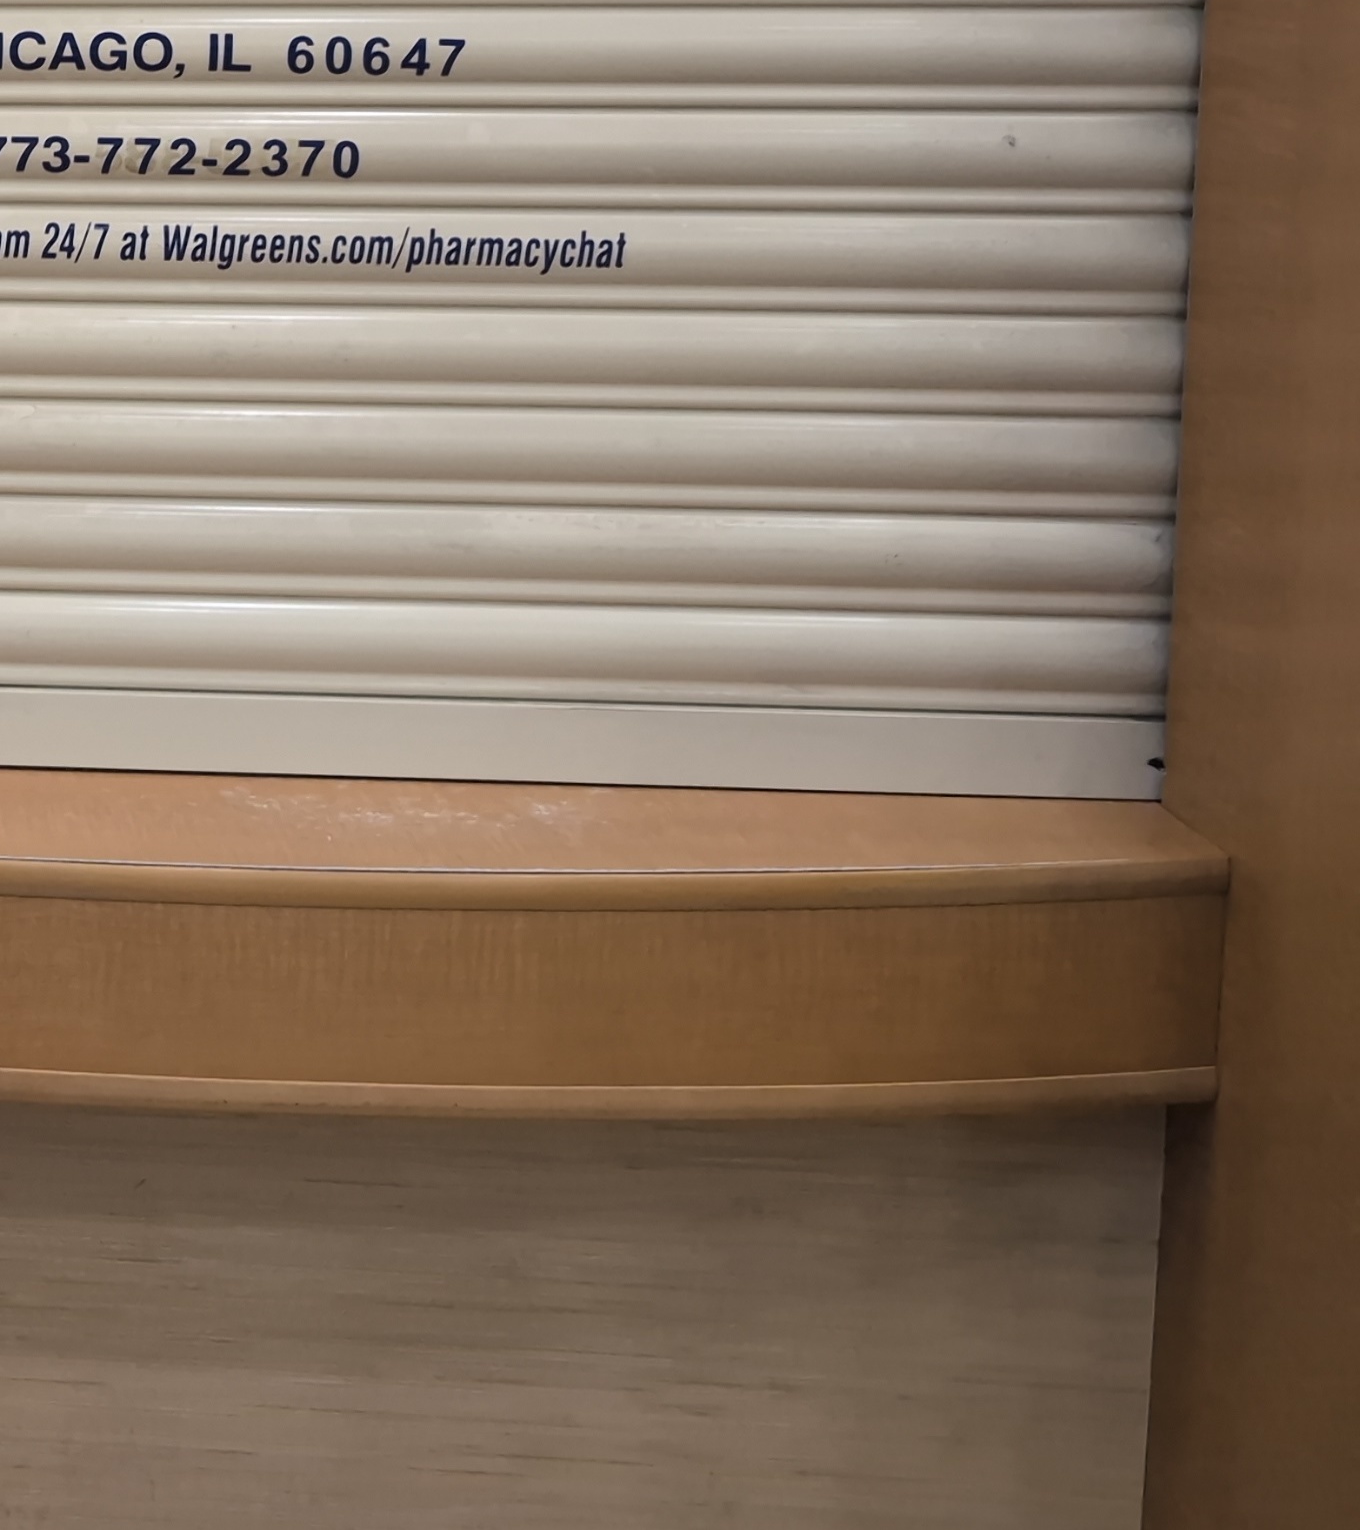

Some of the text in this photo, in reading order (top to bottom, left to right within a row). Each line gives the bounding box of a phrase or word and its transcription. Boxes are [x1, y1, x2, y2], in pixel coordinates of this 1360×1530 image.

[207, 33, 252, 73] IL
[287, 35, 466, 77] 60647
[41, 222, 110, 264] 24/7
[119, 225, 149, 261] at
[163, 224, 626, 276] Walgreens.com/pharmacychat
